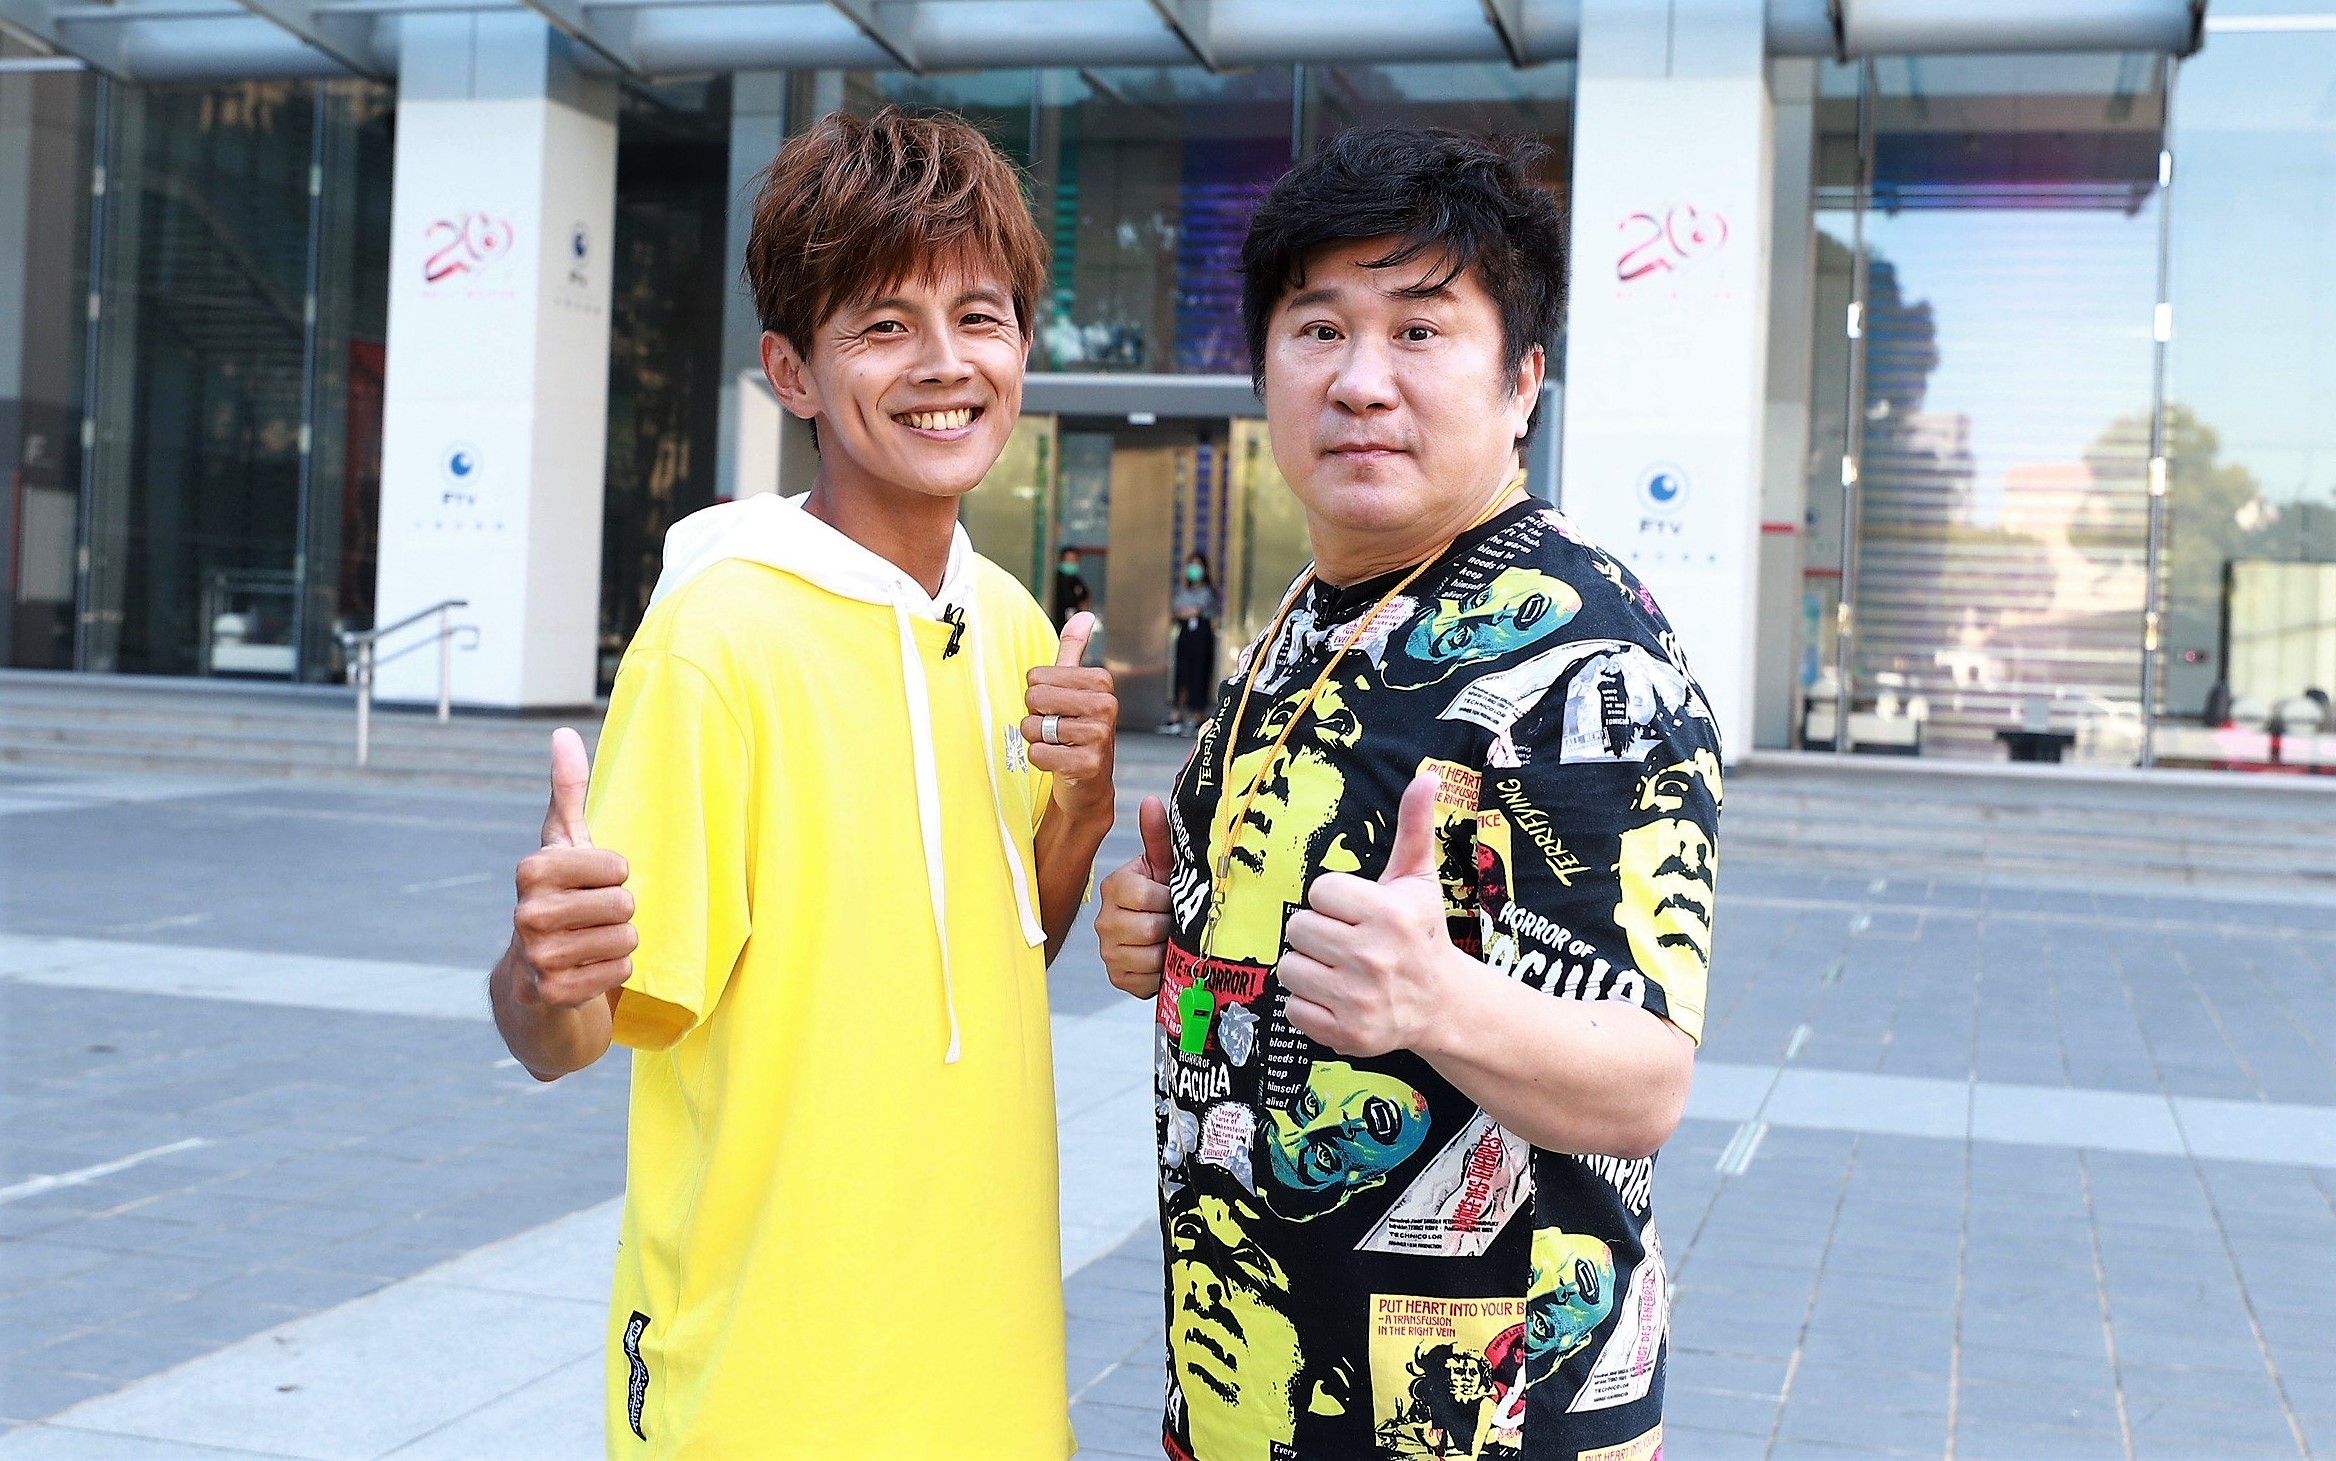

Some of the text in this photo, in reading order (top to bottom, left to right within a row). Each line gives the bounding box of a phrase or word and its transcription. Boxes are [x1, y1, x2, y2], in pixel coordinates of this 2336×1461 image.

[1476, 543, 1503, 558] blood
[1450, 578, 1487, 591] himself
[1196, 695, 1232, 796] TERRIFYING
[1446, 767, 1482, 790] HEART
[1496, 778, 1592, 888] TERRIFYING
[1568, 939, 1597, 958] OF
[1270, 1022, 1286, 1033] the
[1269, 1037, 1309, 1051] blood he
[1267, 1054, 1309, 1065] needs to
[1267, 1067, 1288, 1080] keep
[1267, 1081, 1302, 1095] himself
[1265, 1096, 1290, 1109] alive!
[1389, 1231, 1443, 1240] TECHNICOLOR
[1379, 1299, 1402, 1313] PUT
[1405, 1300, 1447, 1315] HEART
[1450, 1302, 1478, 1316] INTO
[1481, 1302, 1512, 1316] YOUR
[1393, 1315, 1452, 1327] TRANSFUSION
[1378, 1326, 1456, 1337] IN THE RIGHT VEIN
[1273, 1443, 1299, 1460] Every
